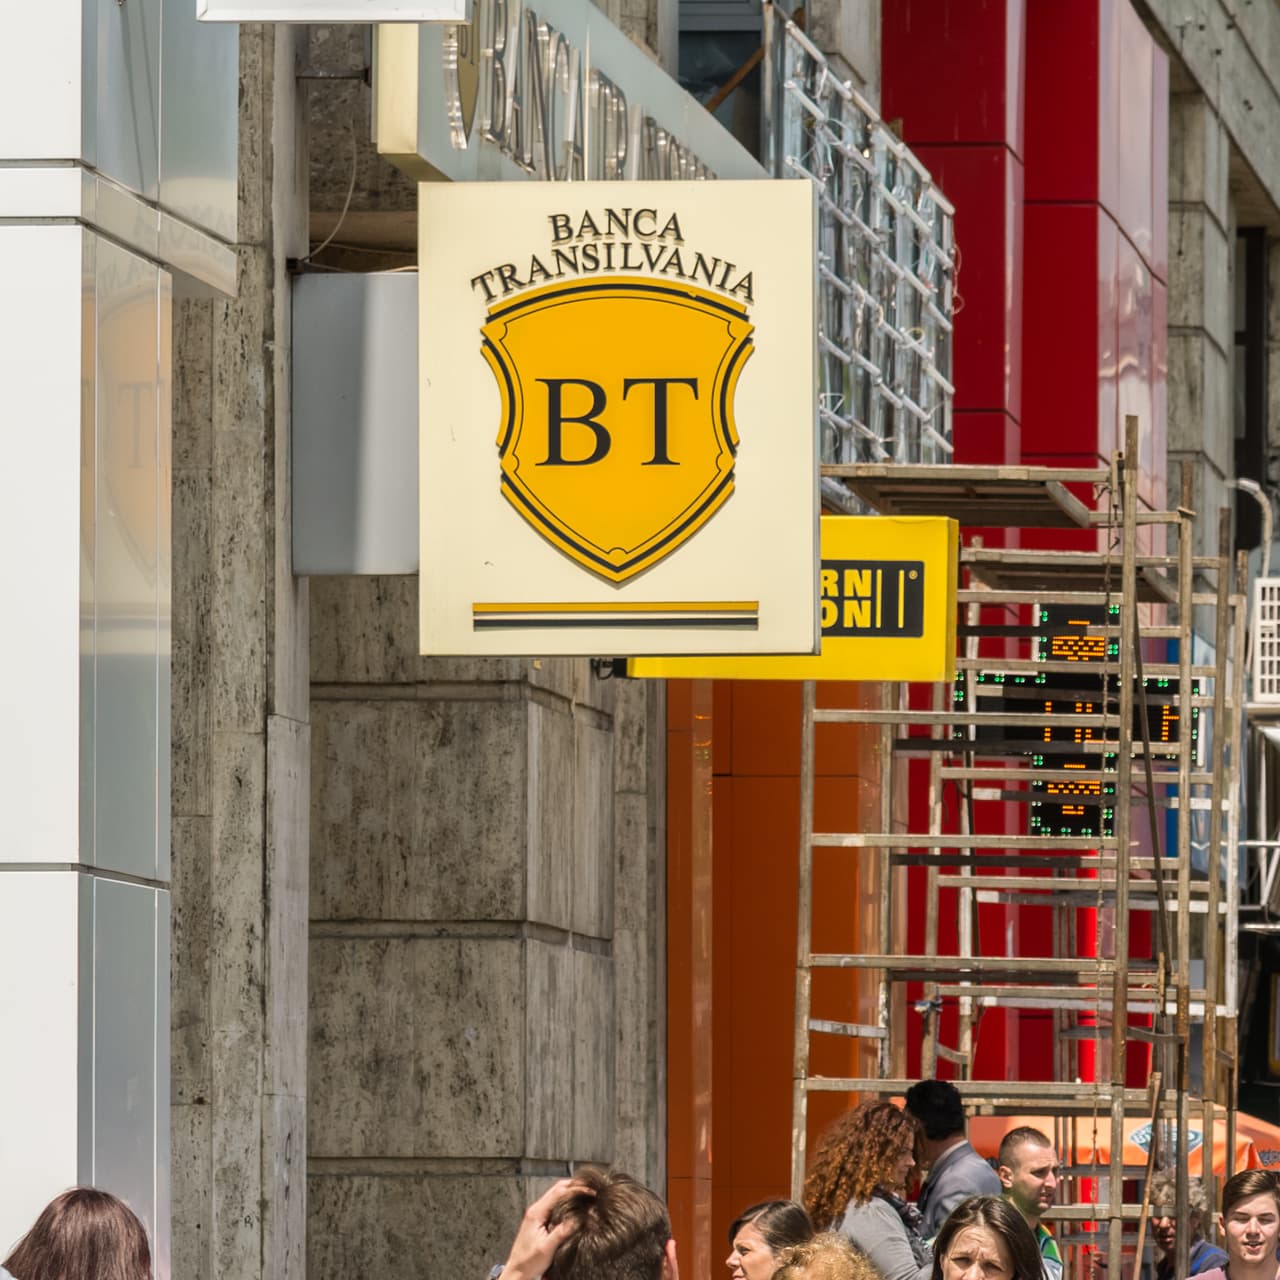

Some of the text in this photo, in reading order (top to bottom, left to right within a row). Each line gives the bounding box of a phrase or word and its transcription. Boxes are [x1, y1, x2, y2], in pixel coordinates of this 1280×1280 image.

[548, 207, 685, 243] BANCA
[471, 241, 756, 305] TRANSILVANIA
[534, 377, 699, 467] BT
